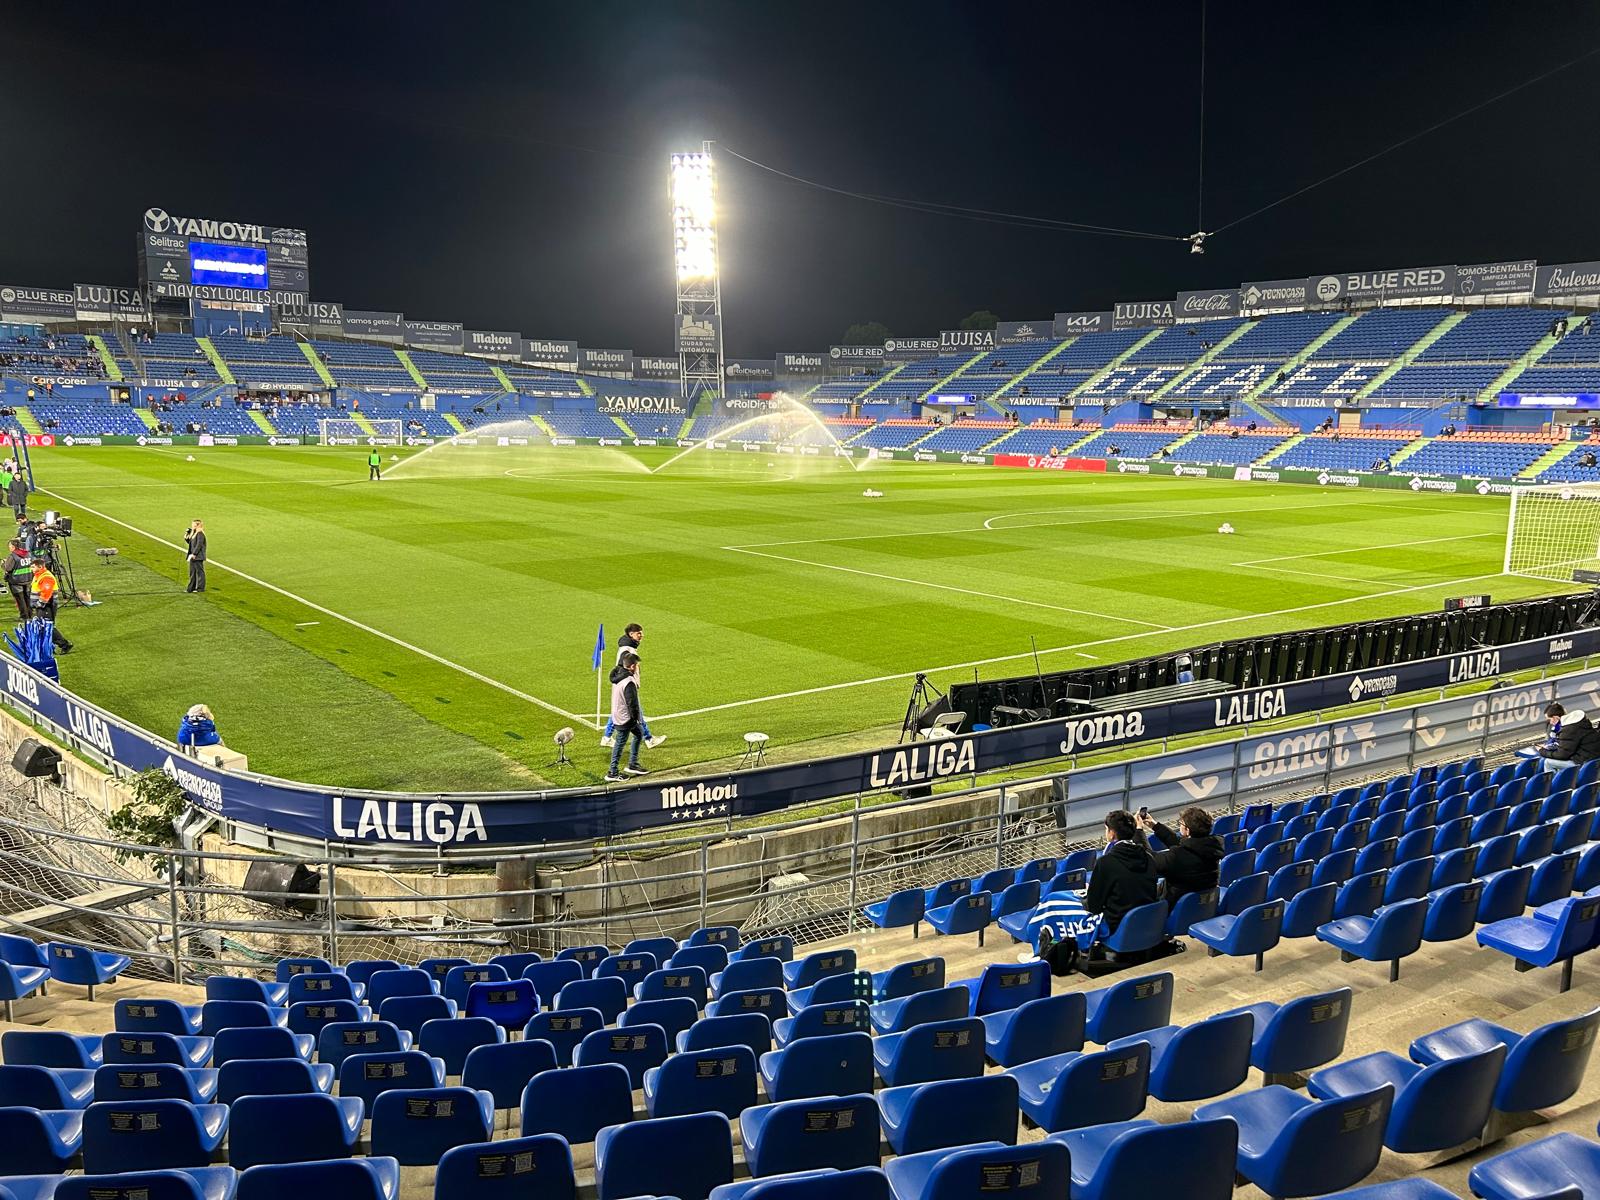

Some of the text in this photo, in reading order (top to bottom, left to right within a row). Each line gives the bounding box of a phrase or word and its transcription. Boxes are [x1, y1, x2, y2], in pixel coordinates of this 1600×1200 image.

[171, 216, 270, 243] YAMOVIL
[149, 235, 185, 248] Selitrac
[1457, 263, 1534, 276] SOMOS-DENTAL.ES
[1347, 269, 1446, 290] BLUE RED
[1548, 268, 1600, 288] Buleva
[17, 289, 47, 300] BLUE
[50, 291, 73, 303] RED
[76, 286, 143, 306] LUJISA
[281, 303, 342, 319] LUJISA
[1115, 303, 1174, 319] LUJISA
[405, 322, 462, 331] VITALDENT
[472, 333, 513, 345] Mahou
[941, 332, 994, 345] LUJISA
[530, 342, 569, 353] Mahou
[842, 348, 883, 356] BLUE RED
[586, 350, 624, 362] Mahou
[784, 355, 822, 366] Mahou
[641, 359, 679, 370] Mahou
[57, 376, 87, 385] Corea
[155, 379, 184, 387] LUJISA
[604, 396, 681, 410] YAMOVIL
[1009, 398, 1043, 406] YAMOVIL
[1080, 398, 1104, 406] LUJISA
[1295, 399, 1326, 407] LUJISA
[1550, 639, 1573, 653] Mahou
[1448, 650, 1500, 684] LALIGA
[1214, 688, 1286, 727] LALIGA
[66, 701, 114, 756] LALIGA
[870, 739, 976, 788] LALIGA
[177, 769, 223, 804] TECNOCASA
[660, 782, 739, 810] Mahou
[333, 797, 487, 842] LALIGA
